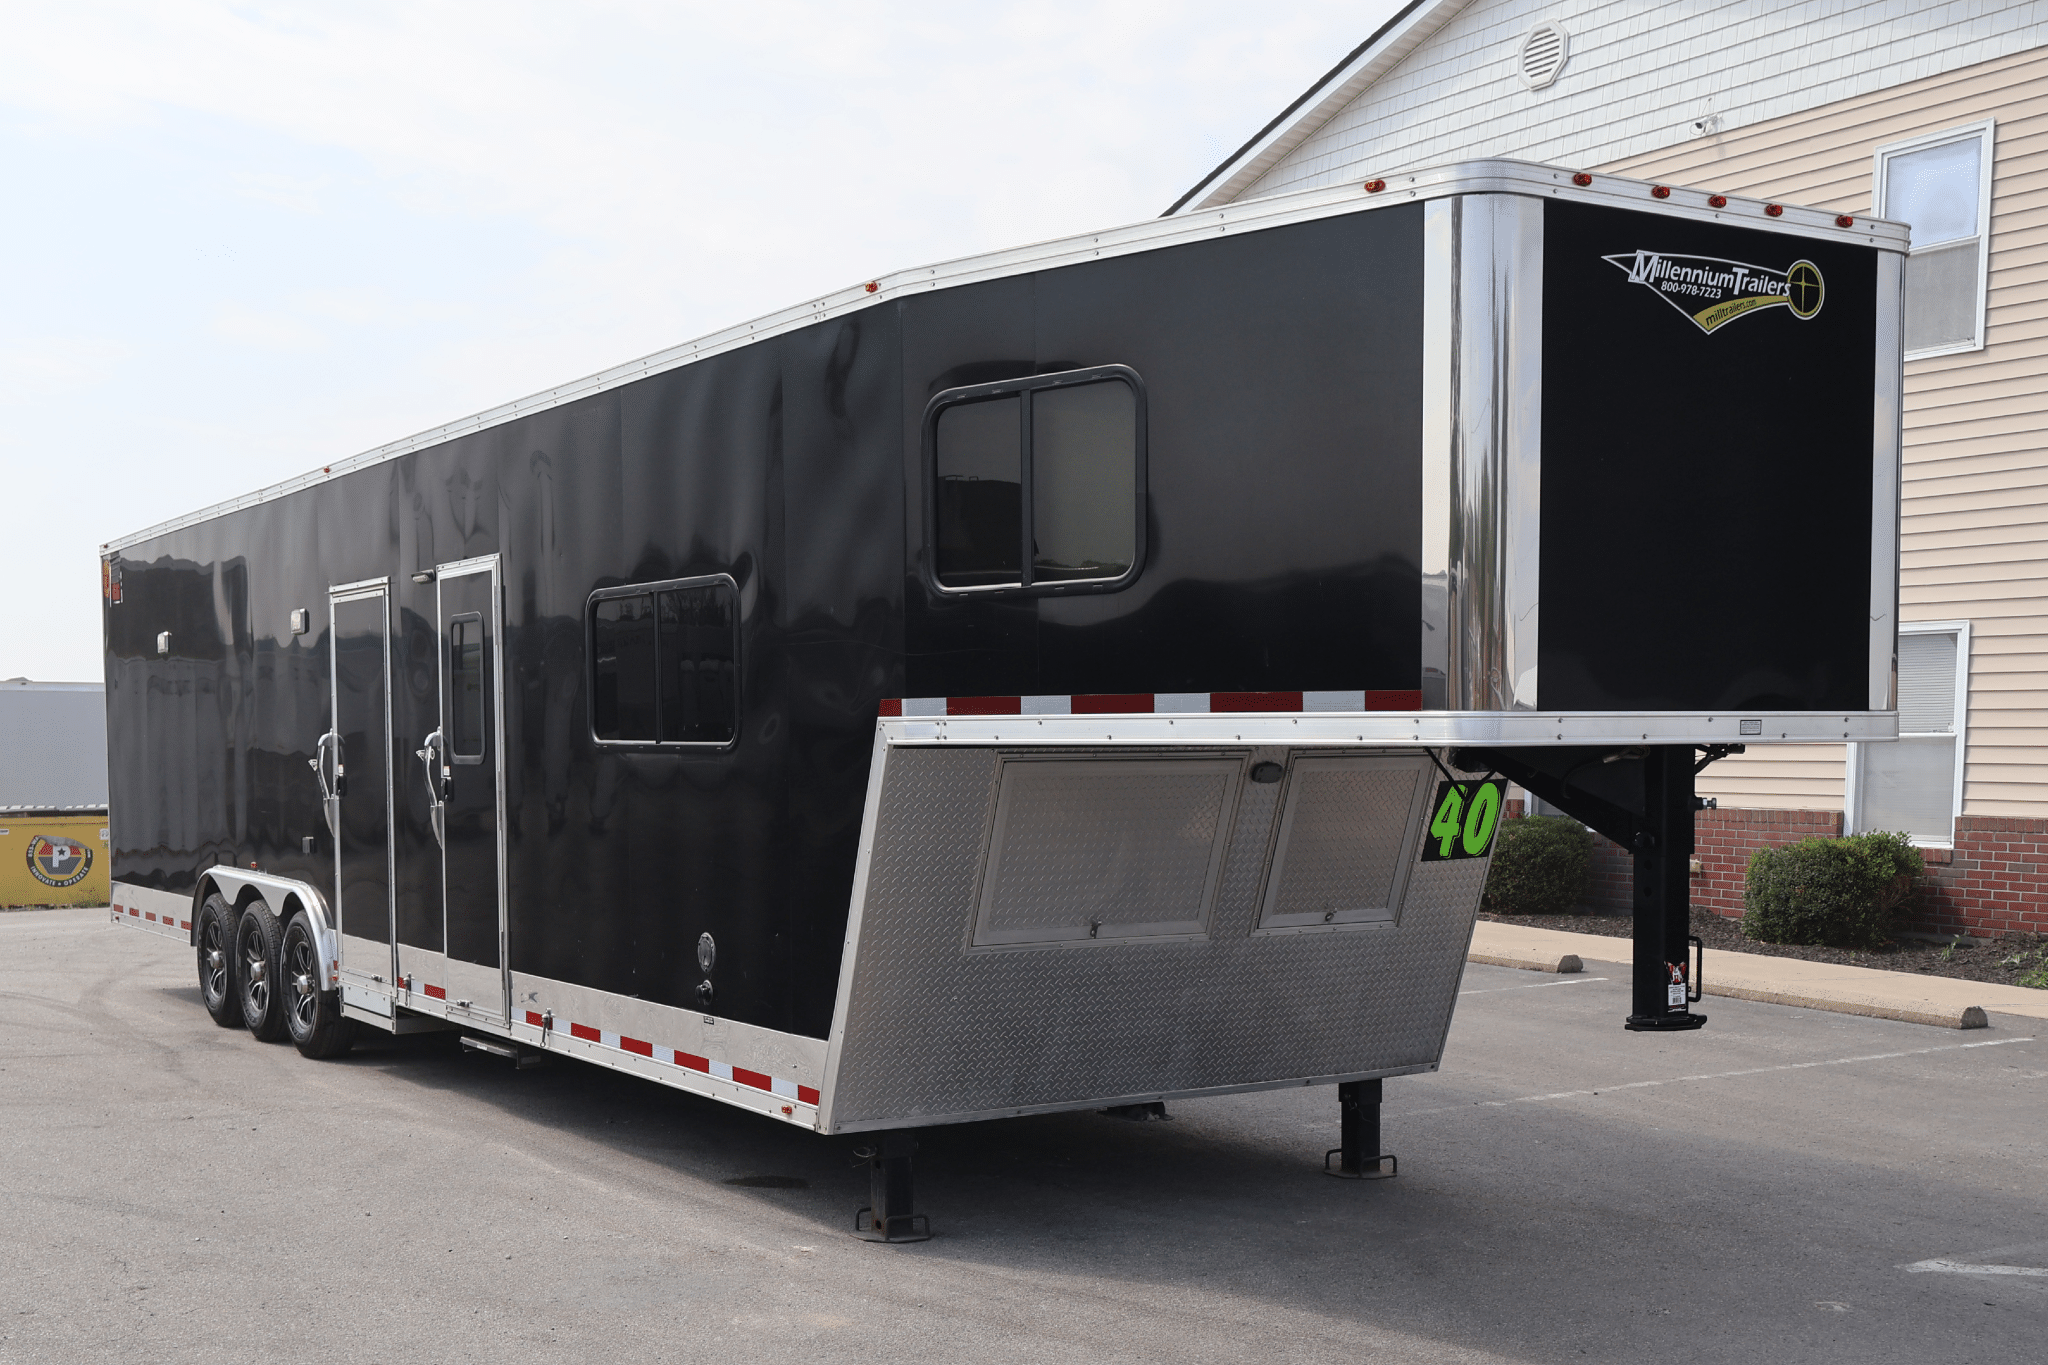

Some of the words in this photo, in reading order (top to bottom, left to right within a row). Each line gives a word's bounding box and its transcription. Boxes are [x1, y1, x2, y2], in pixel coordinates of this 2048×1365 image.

[1661, 281, 1722, 299] 800-978-7223
[1705, 299, 1757, 326] milltrailers.com
[1430, 782, 1500, 859] 40
[52, 845, 71, 868] P
[30, 866, 56, 886] INNOVATE
[63, 867, 89, 886] OPERATE
